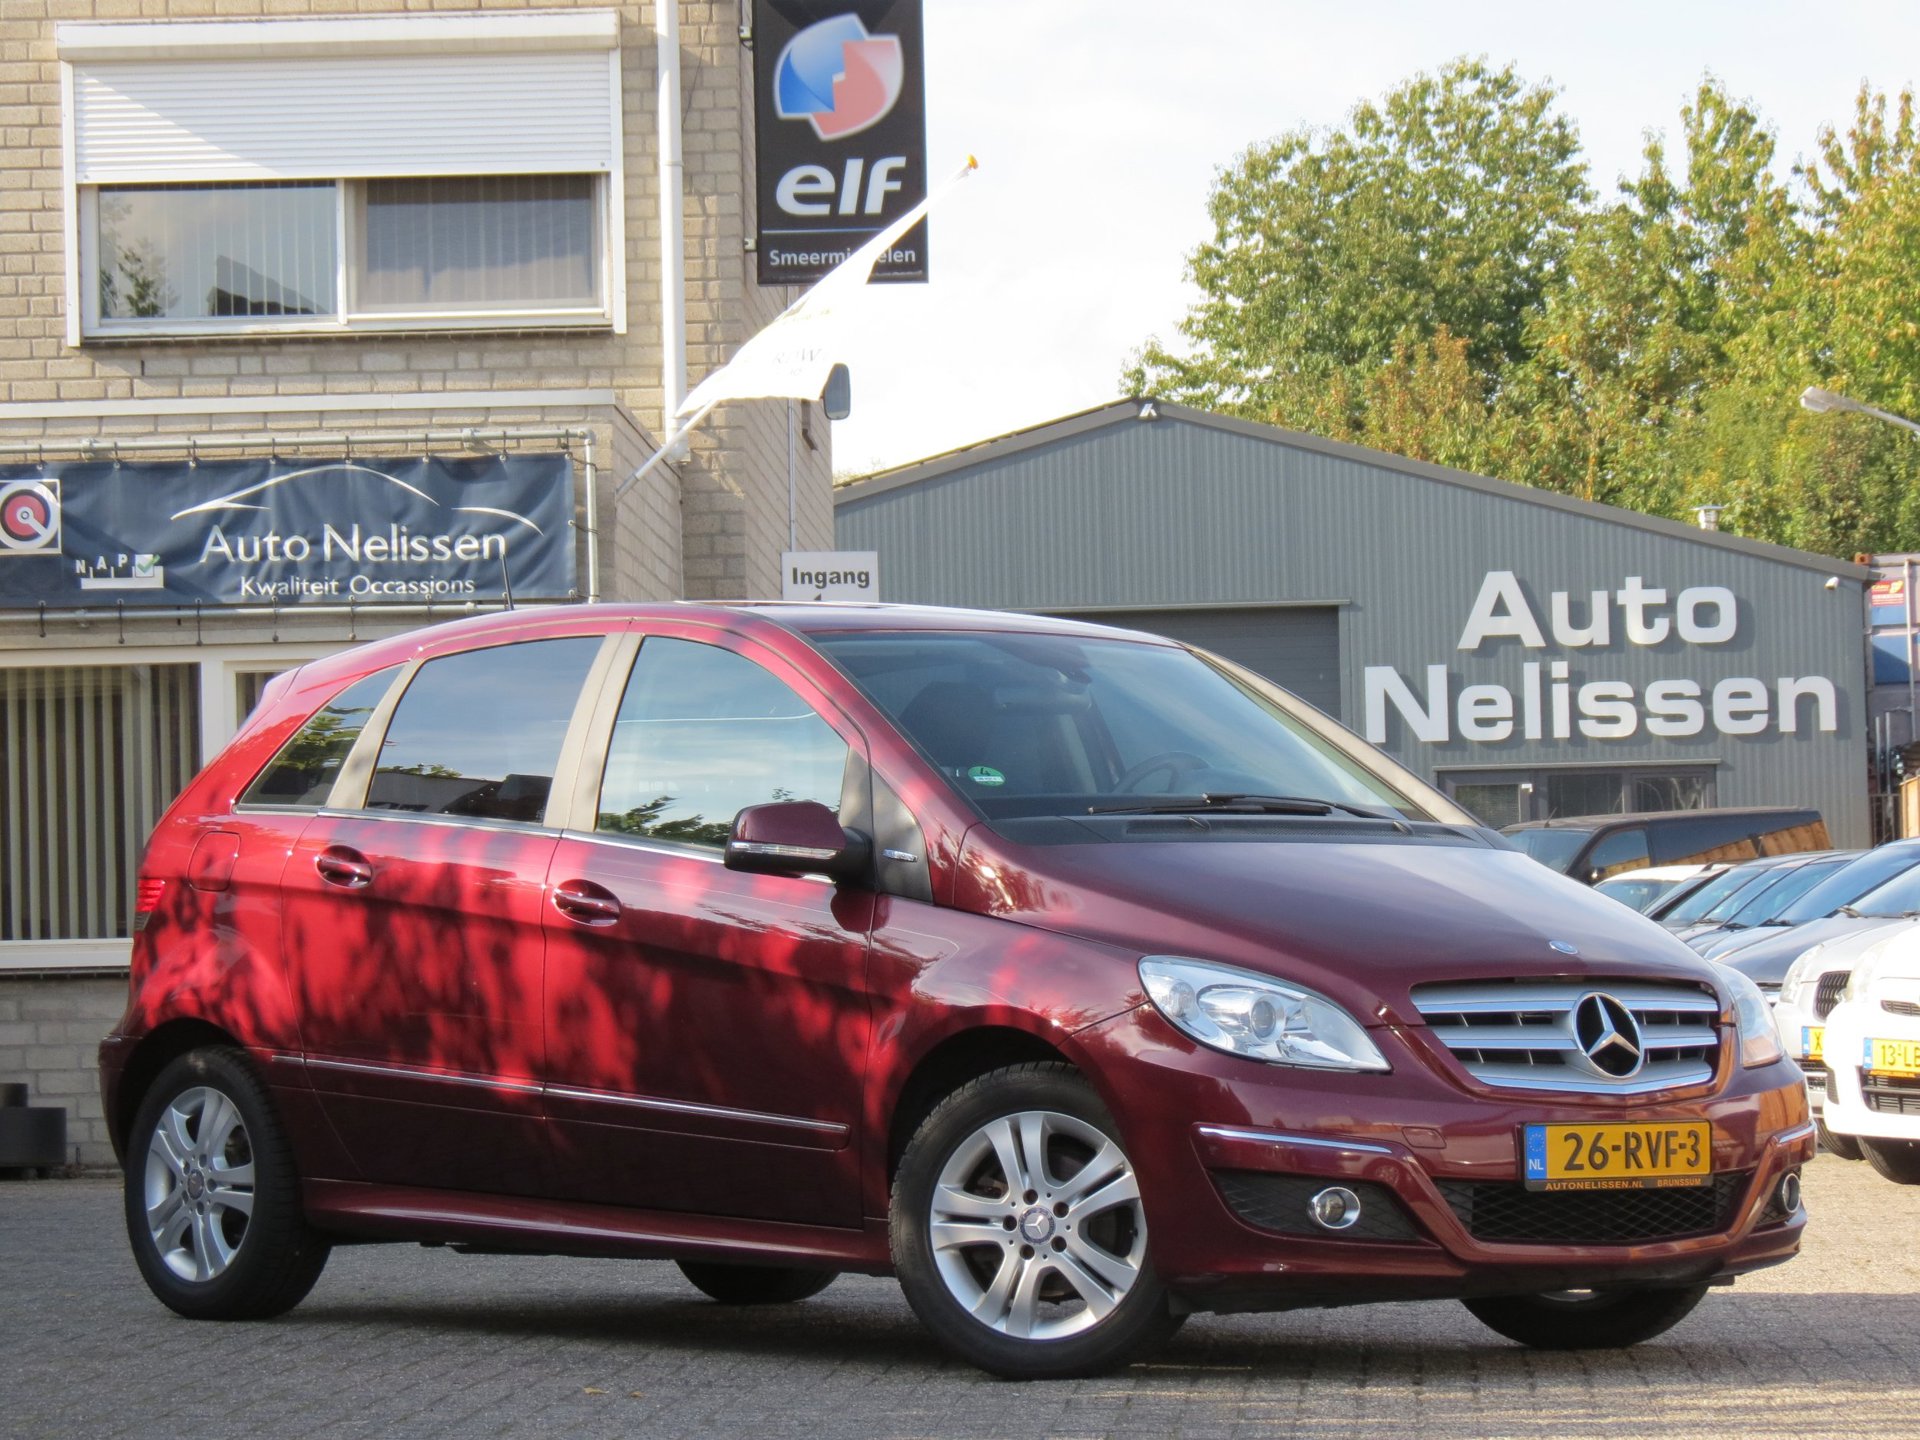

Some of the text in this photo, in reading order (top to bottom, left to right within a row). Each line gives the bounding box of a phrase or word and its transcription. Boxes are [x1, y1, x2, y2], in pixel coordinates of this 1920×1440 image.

[776, 156, 906, 215] elf
[770, 247, 916, 266] Smeermielen
[200, 523, 506, 563] Auto Nelissen
[240, 575, 476, 596] Kwaliteit Occassions
[792, 567, 870, 588] Ingang
[1457, 570, 1738, 650] Auto
[1364, 660, 1838, 743] Nelissen
[1528, 1159, 1544, 1171] NL
[1563, 1130, 1701, 1171] 26-RVF-3
[1545, 1178, 1702, 1191] AUTONELISSEN.NL BRUNSSUM
